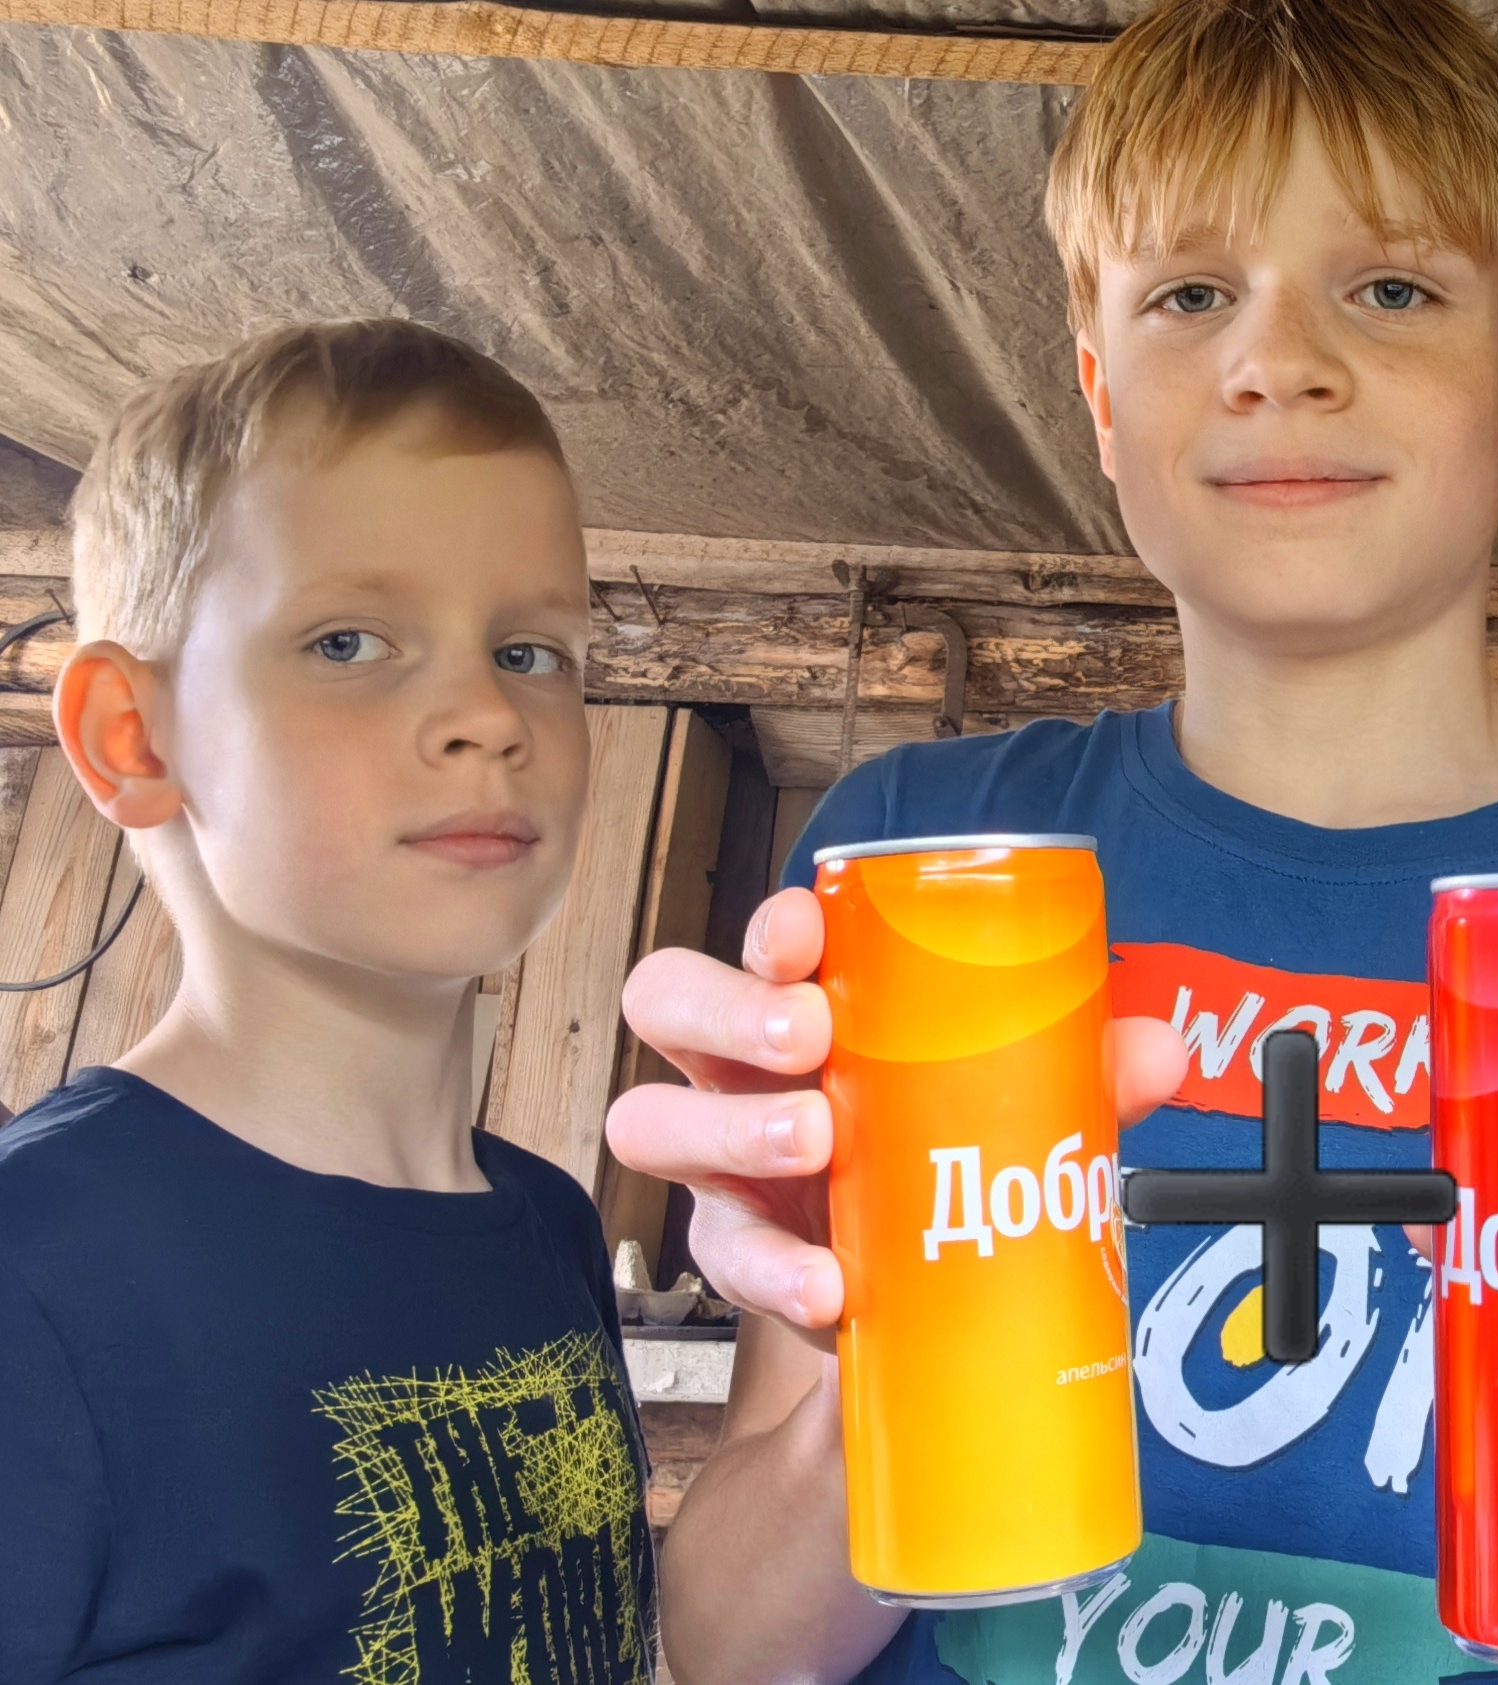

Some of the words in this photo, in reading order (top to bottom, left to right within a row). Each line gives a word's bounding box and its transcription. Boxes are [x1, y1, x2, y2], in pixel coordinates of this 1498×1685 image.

[922, 1131, 1122, 1261] Добр
[406, 1526, 646, 1685] WORL
[1055, 1572, 1356, 1685] YOUR
